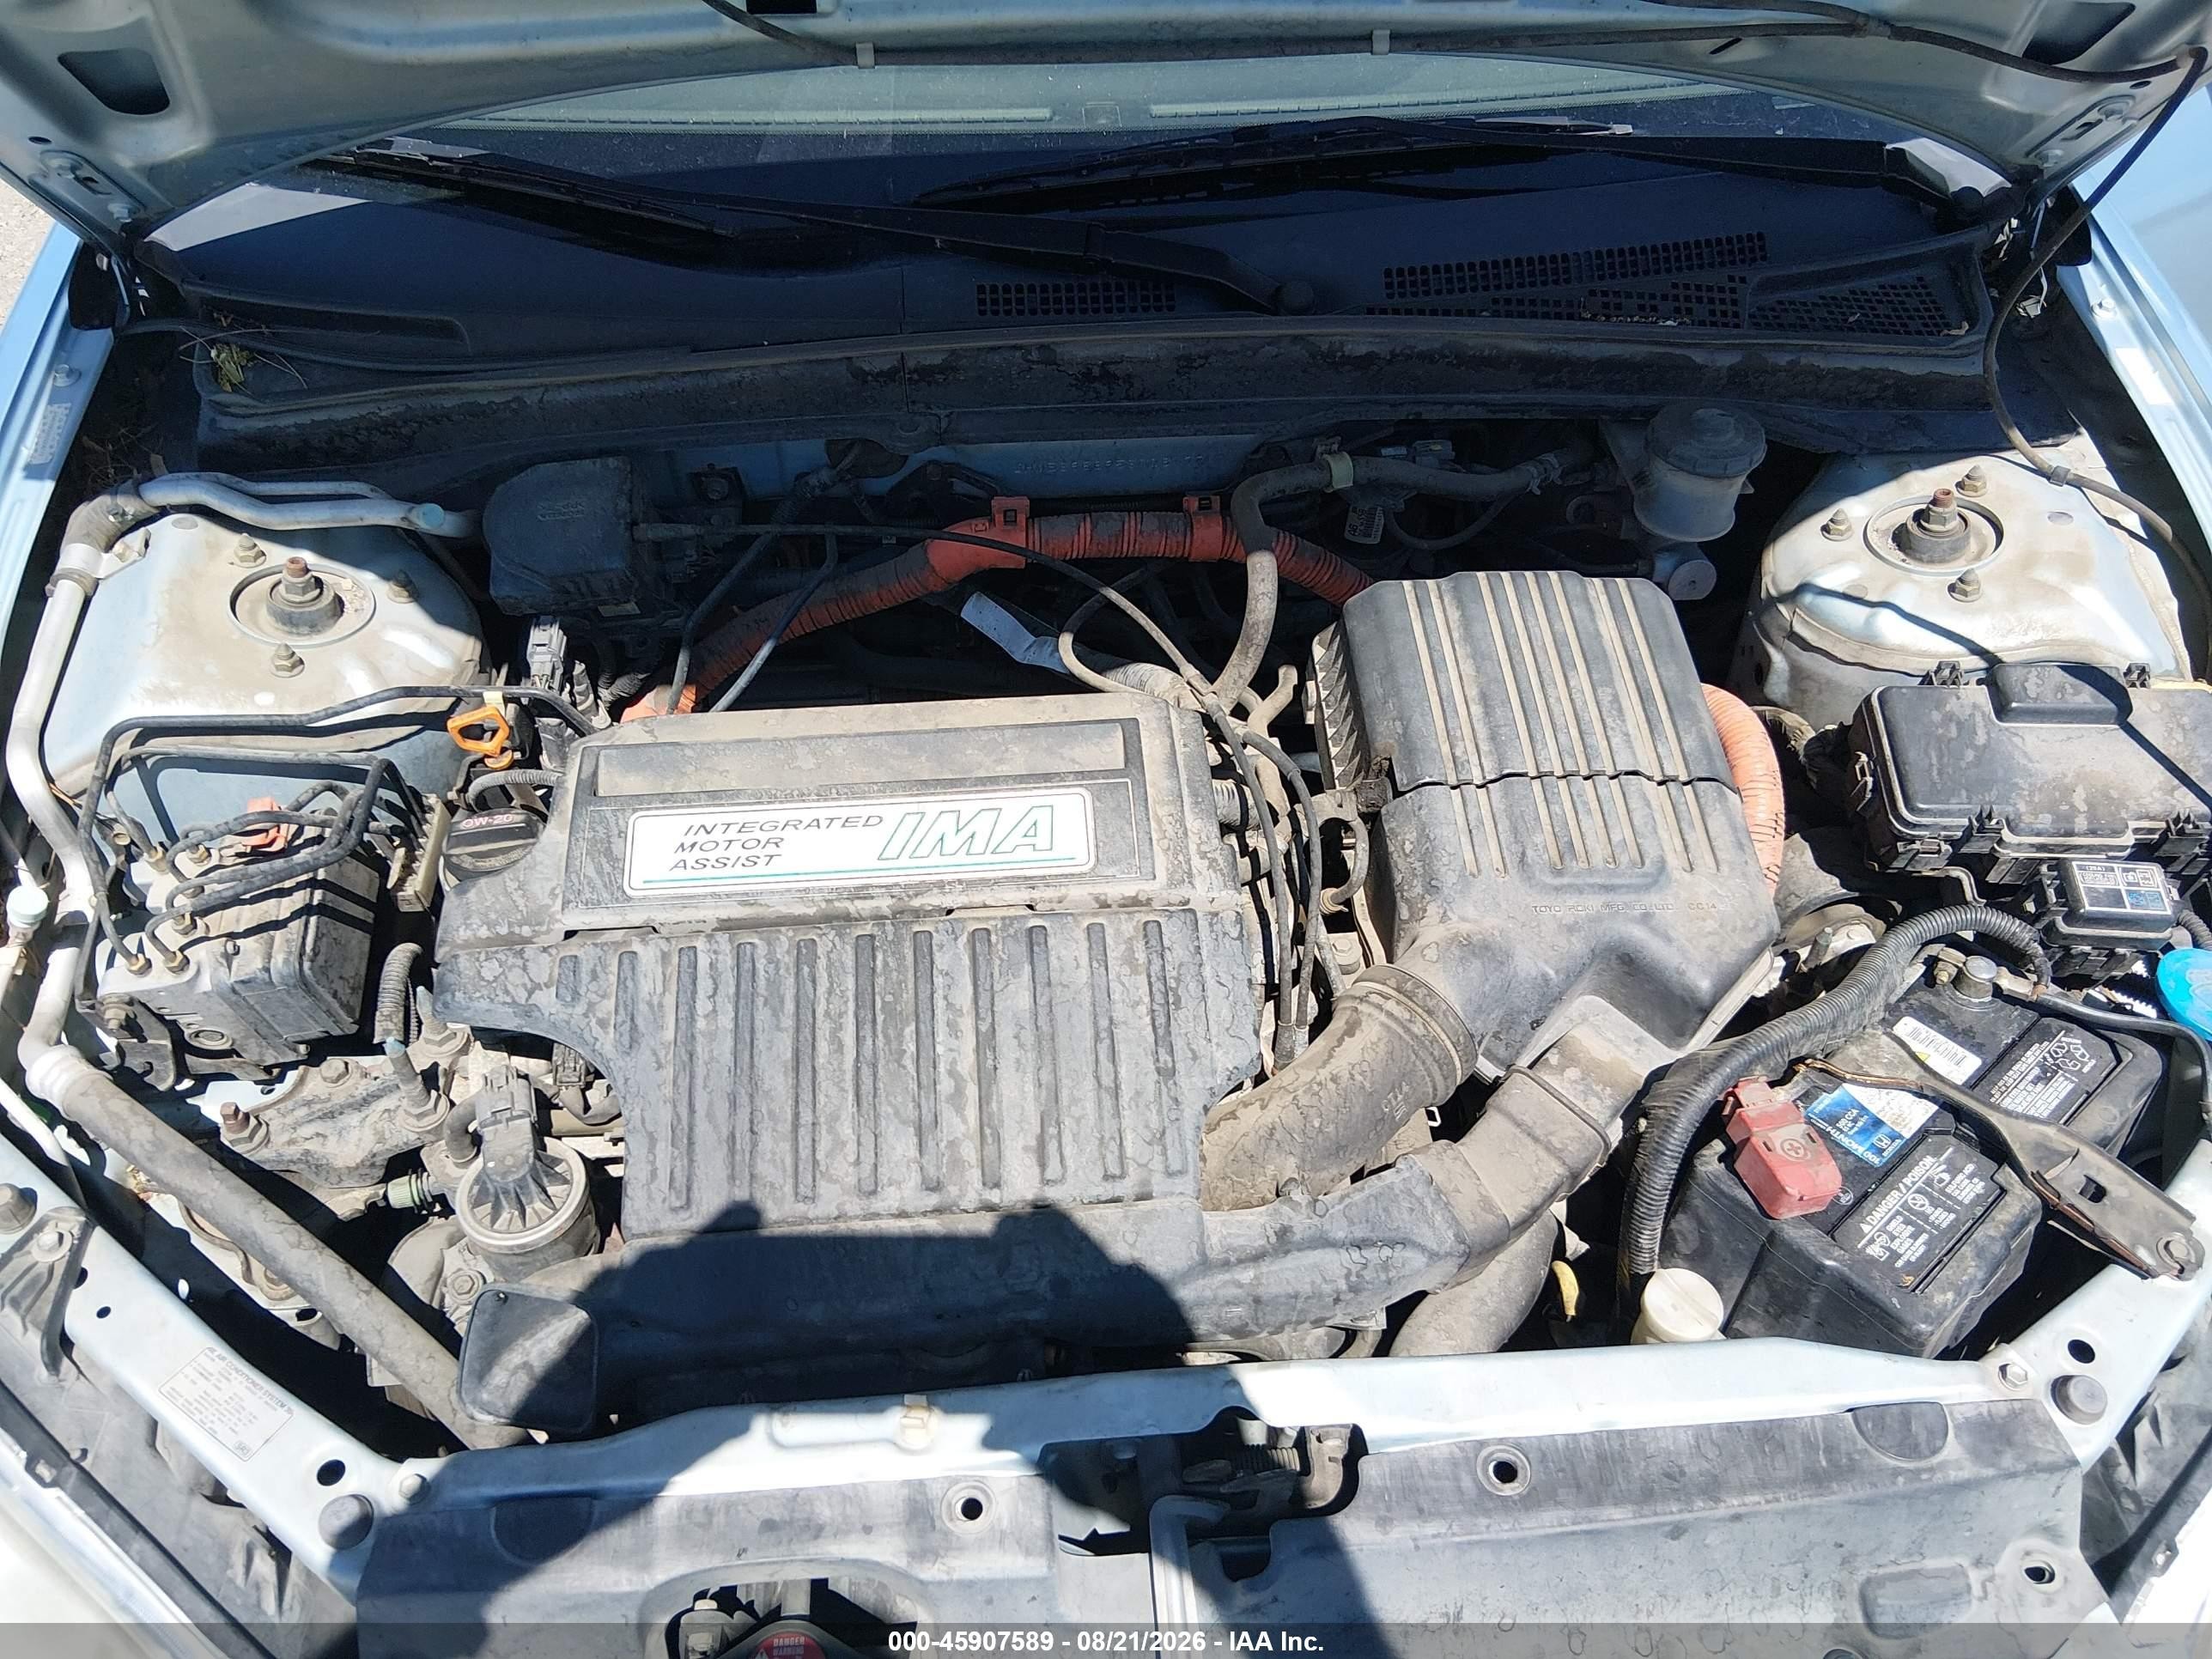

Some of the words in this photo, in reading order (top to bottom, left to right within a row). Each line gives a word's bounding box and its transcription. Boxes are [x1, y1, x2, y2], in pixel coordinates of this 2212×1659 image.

[684, 815, 884, 836] INTEGRATED
[878, 805, 1053, 860] IMA
[674, 836, 785, 854] MOTOR
[670, 854, 781, 872] ASSIST
[1532, 904, 1561, 914] TOYO
[1826, 1126, 1866, 1154] MONTH
[1863, 1151, 1881, 1164] 100
